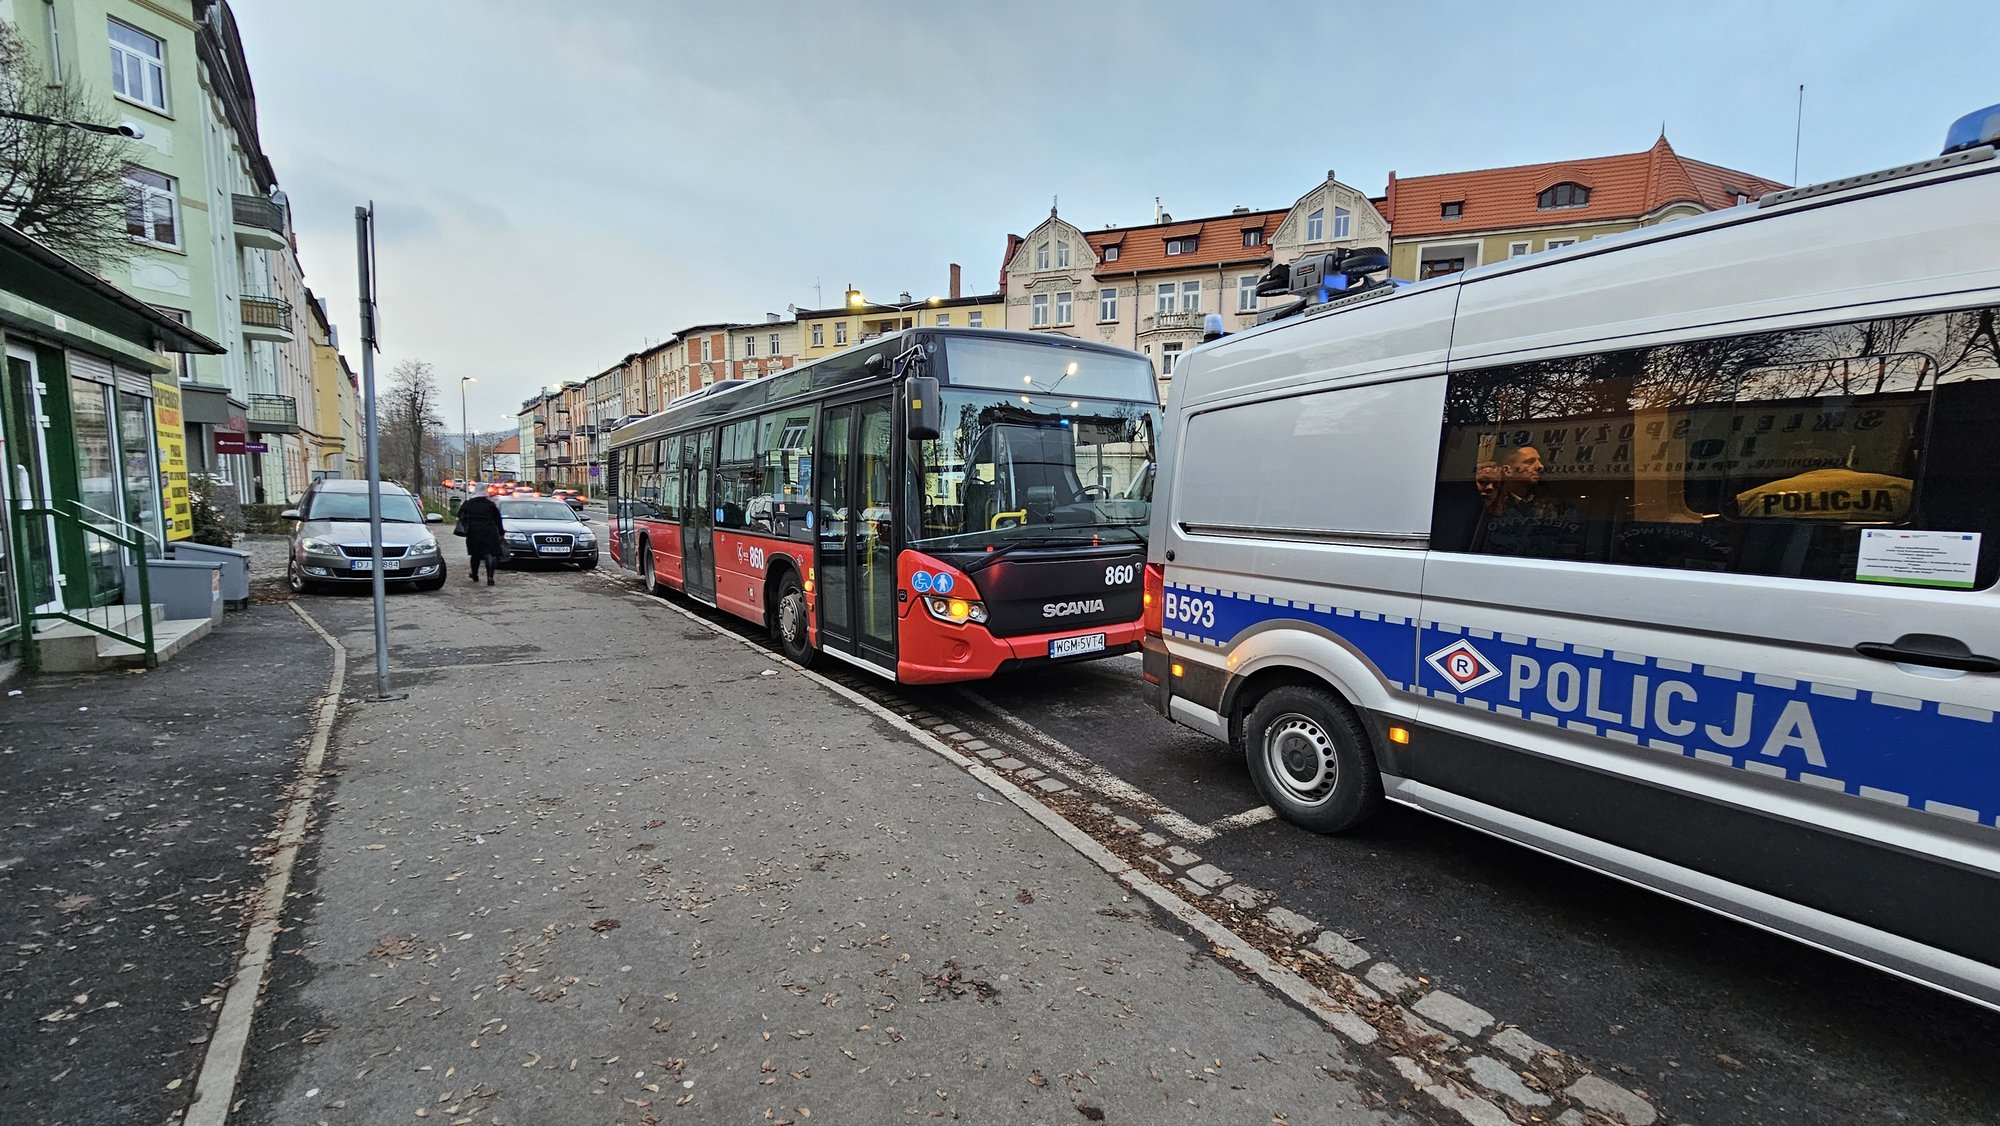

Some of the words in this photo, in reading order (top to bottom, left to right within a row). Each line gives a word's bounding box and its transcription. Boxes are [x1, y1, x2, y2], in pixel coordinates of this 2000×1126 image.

[1764, 489, 1893, 514] POLICJA
[357, 561, 369, 569] DJ
[749, 546, 764, 569] 860
[1104, 565, 1134, 586] 860
[1042, 599, 1105, 618] SCANIA
[1165, 593, 1215, 628] B593
[1457, 658, 1469, 674] R
[1509, 654, 1827, 768] POLICJA
